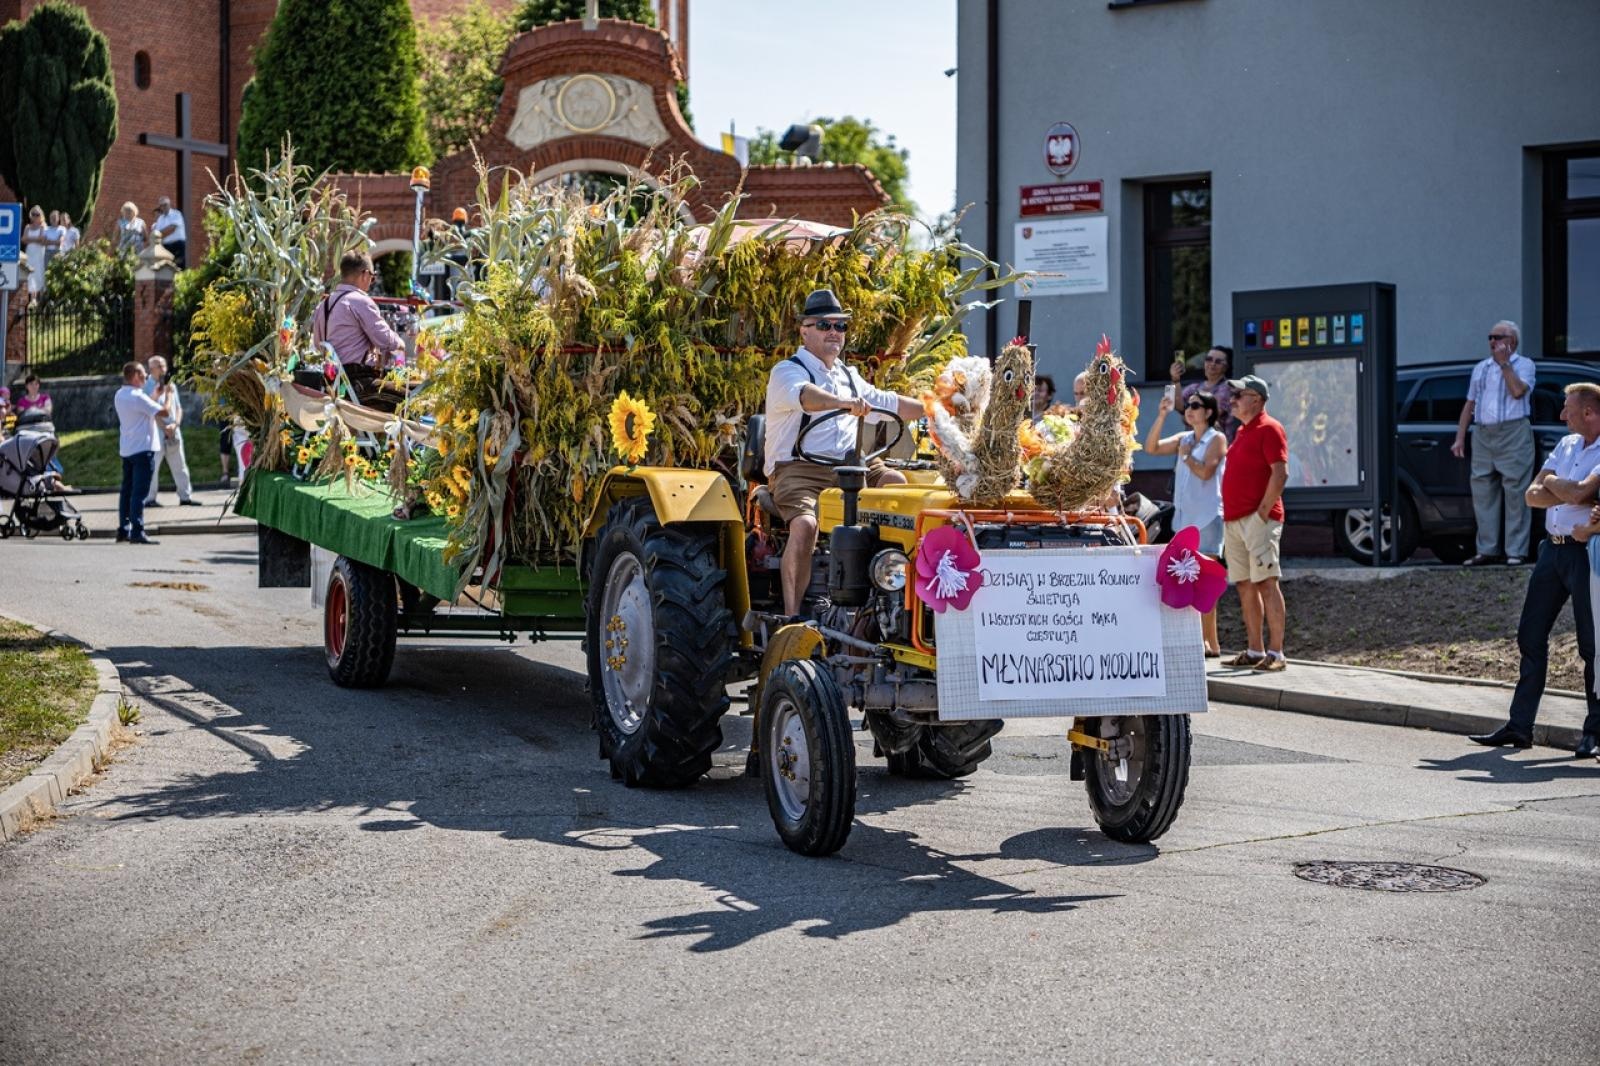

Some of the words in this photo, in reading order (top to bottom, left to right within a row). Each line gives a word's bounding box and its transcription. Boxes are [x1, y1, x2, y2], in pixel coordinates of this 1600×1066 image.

[980, 569, 1035, 591] DZISIAJ
[1037, 574, 1046, 586] W
[1099, 569, 1141, 586] ROLNICY
[981, 612, 986, 627] I
[989, 612, 1048, 626] WSZYSTKICH
[1053, 611, 1083, 626] GOŚCI
[982, 653, 1095, 684] MŁYNARSTWO
[1100, 651, 1160, 681] MODLICH
